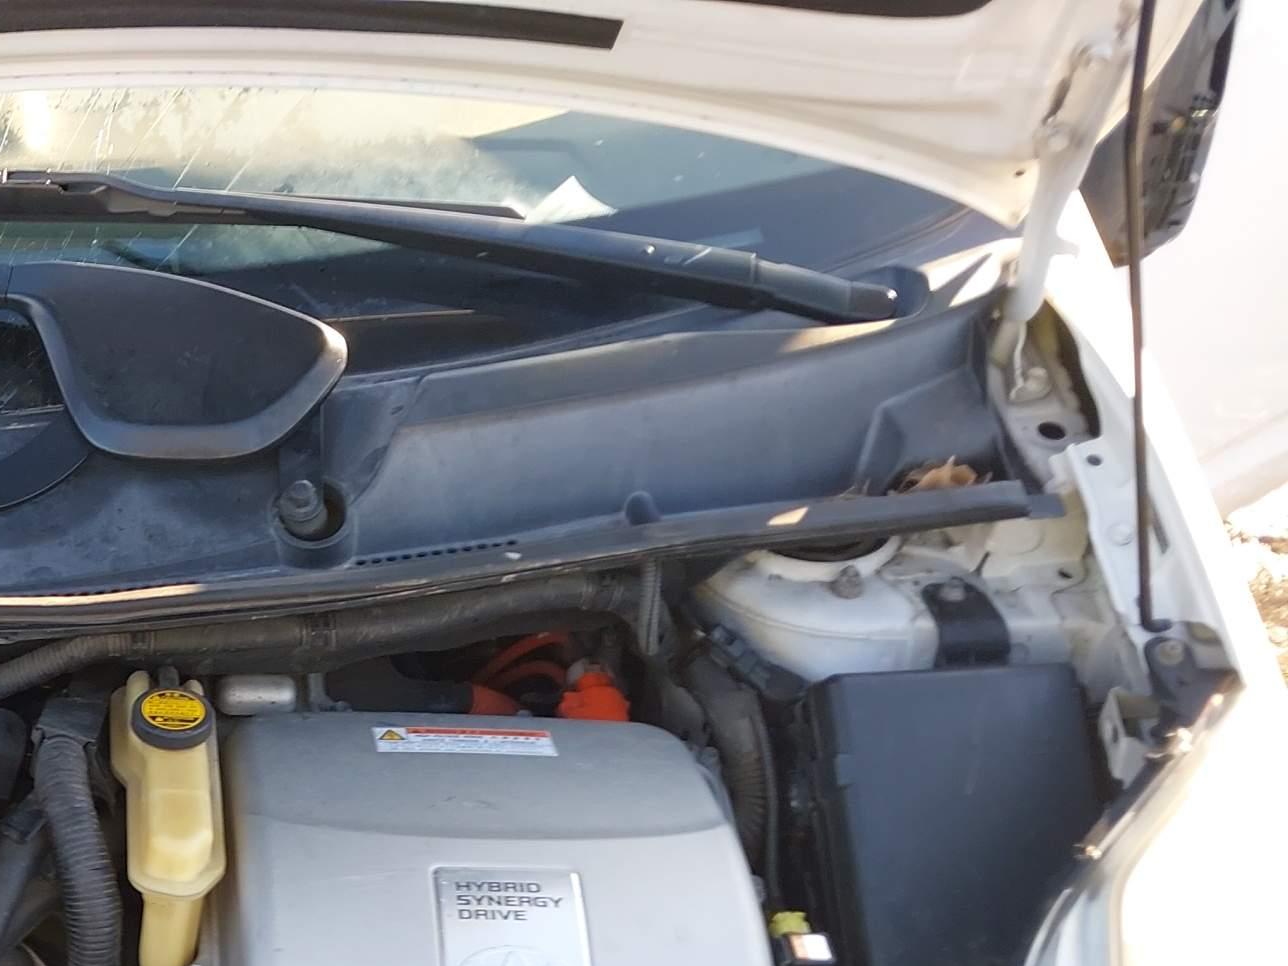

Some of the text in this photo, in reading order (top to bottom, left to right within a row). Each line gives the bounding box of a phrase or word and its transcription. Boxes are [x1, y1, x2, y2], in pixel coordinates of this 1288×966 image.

[455, 881, 542, 893] HYBRID
[456, 894, 564, 908] SYNERGY
[458, 909, 528, 921] DRIVE
